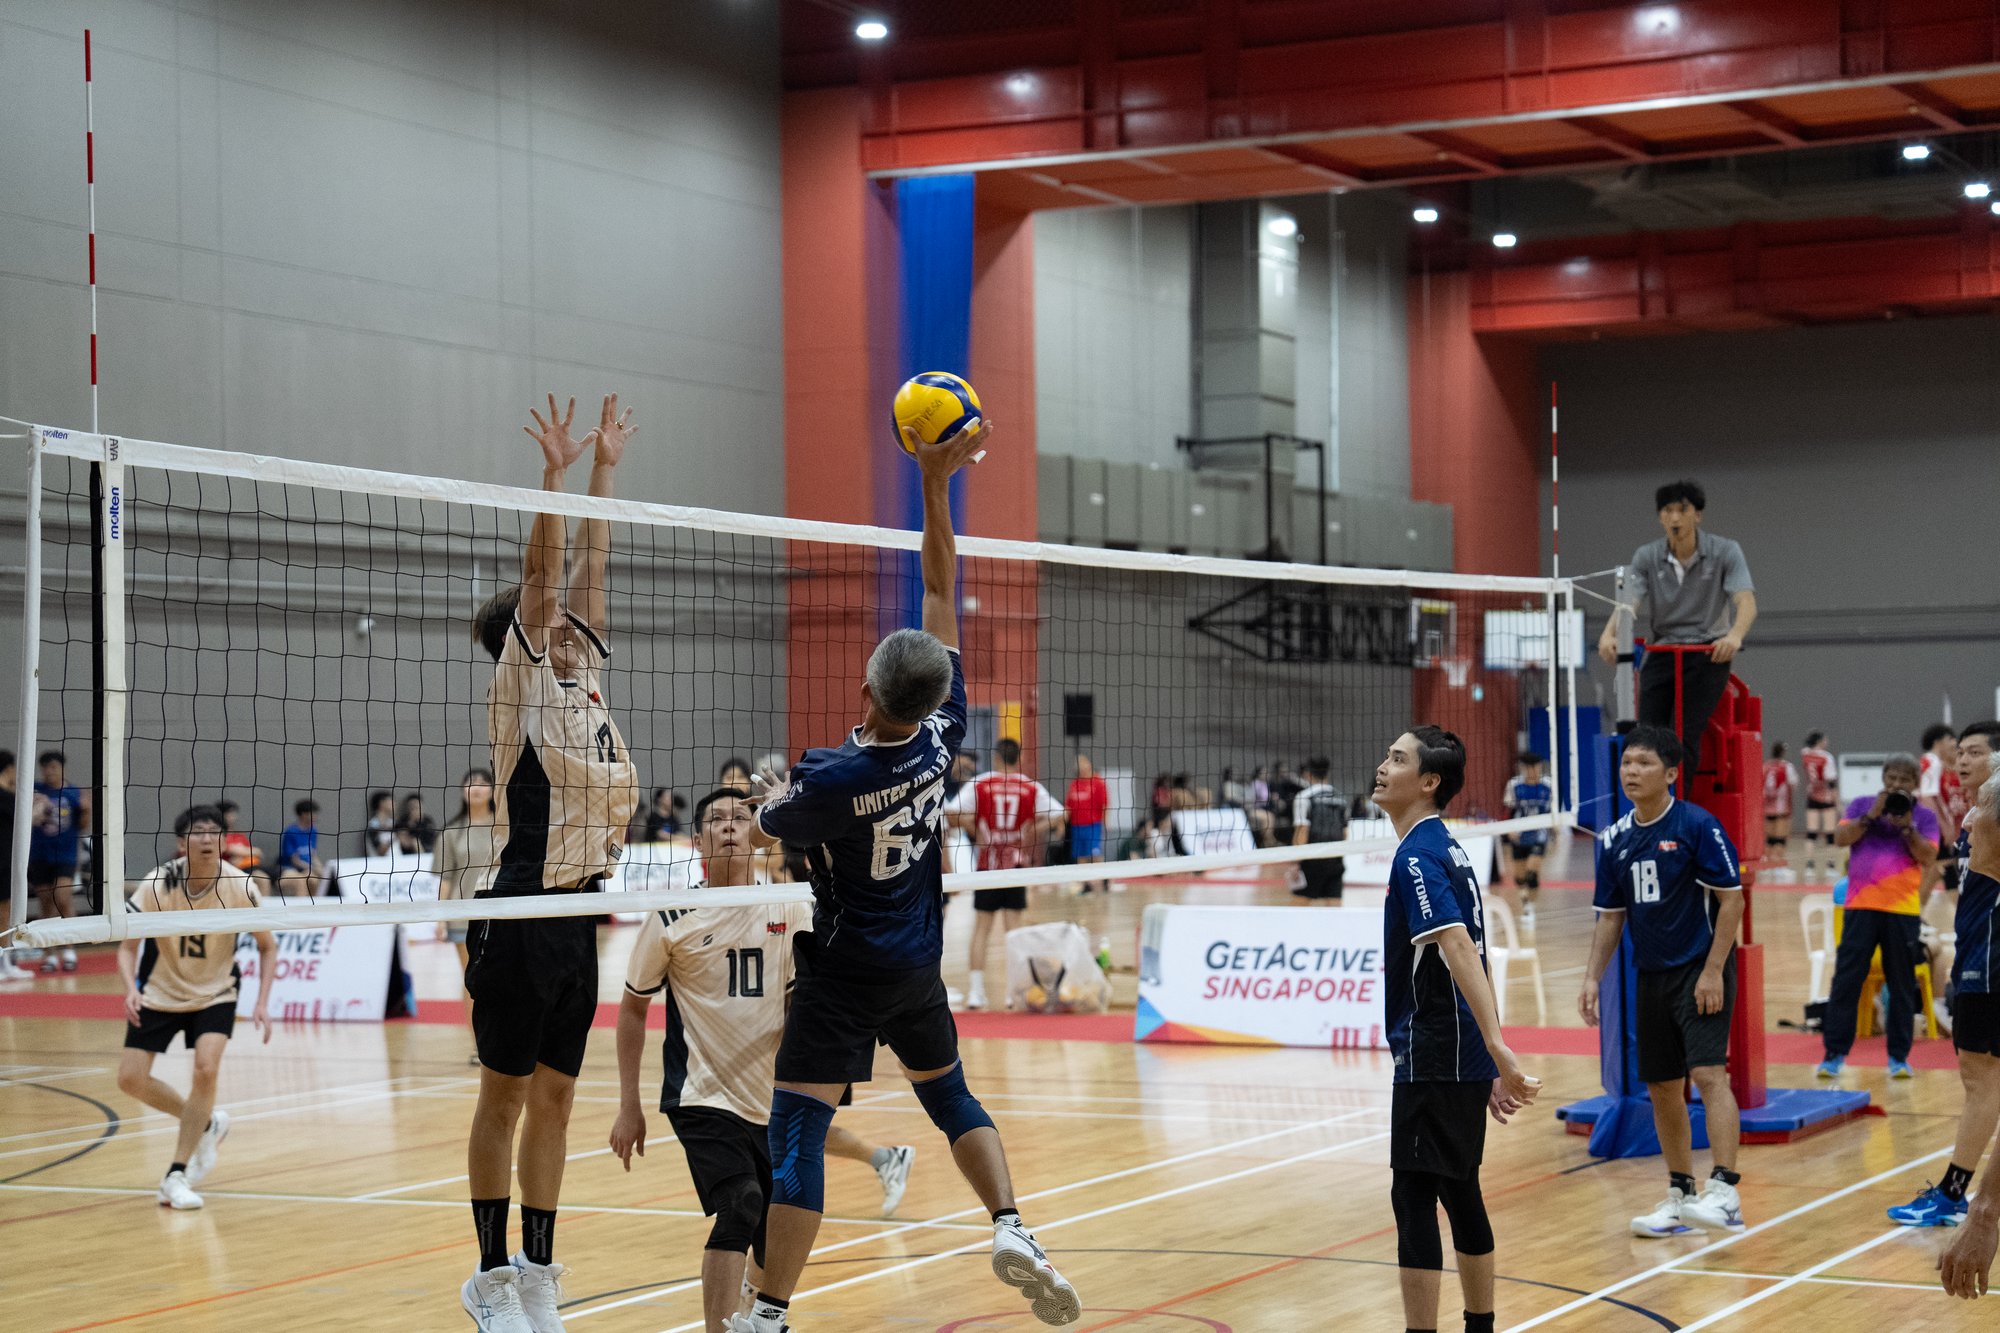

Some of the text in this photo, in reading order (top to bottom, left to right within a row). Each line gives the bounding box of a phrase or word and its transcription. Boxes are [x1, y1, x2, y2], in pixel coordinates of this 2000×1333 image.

[109, 486, 120, 540] molten
[992, 793, 1019, 830] 17
[1630, 859, 1661, 904] 18
[725, 947, 764, 998] 10
[1206, 940, 1385, 973] GETACTIVE
[1203, 975, 1376, 1002] SINGAPORE
